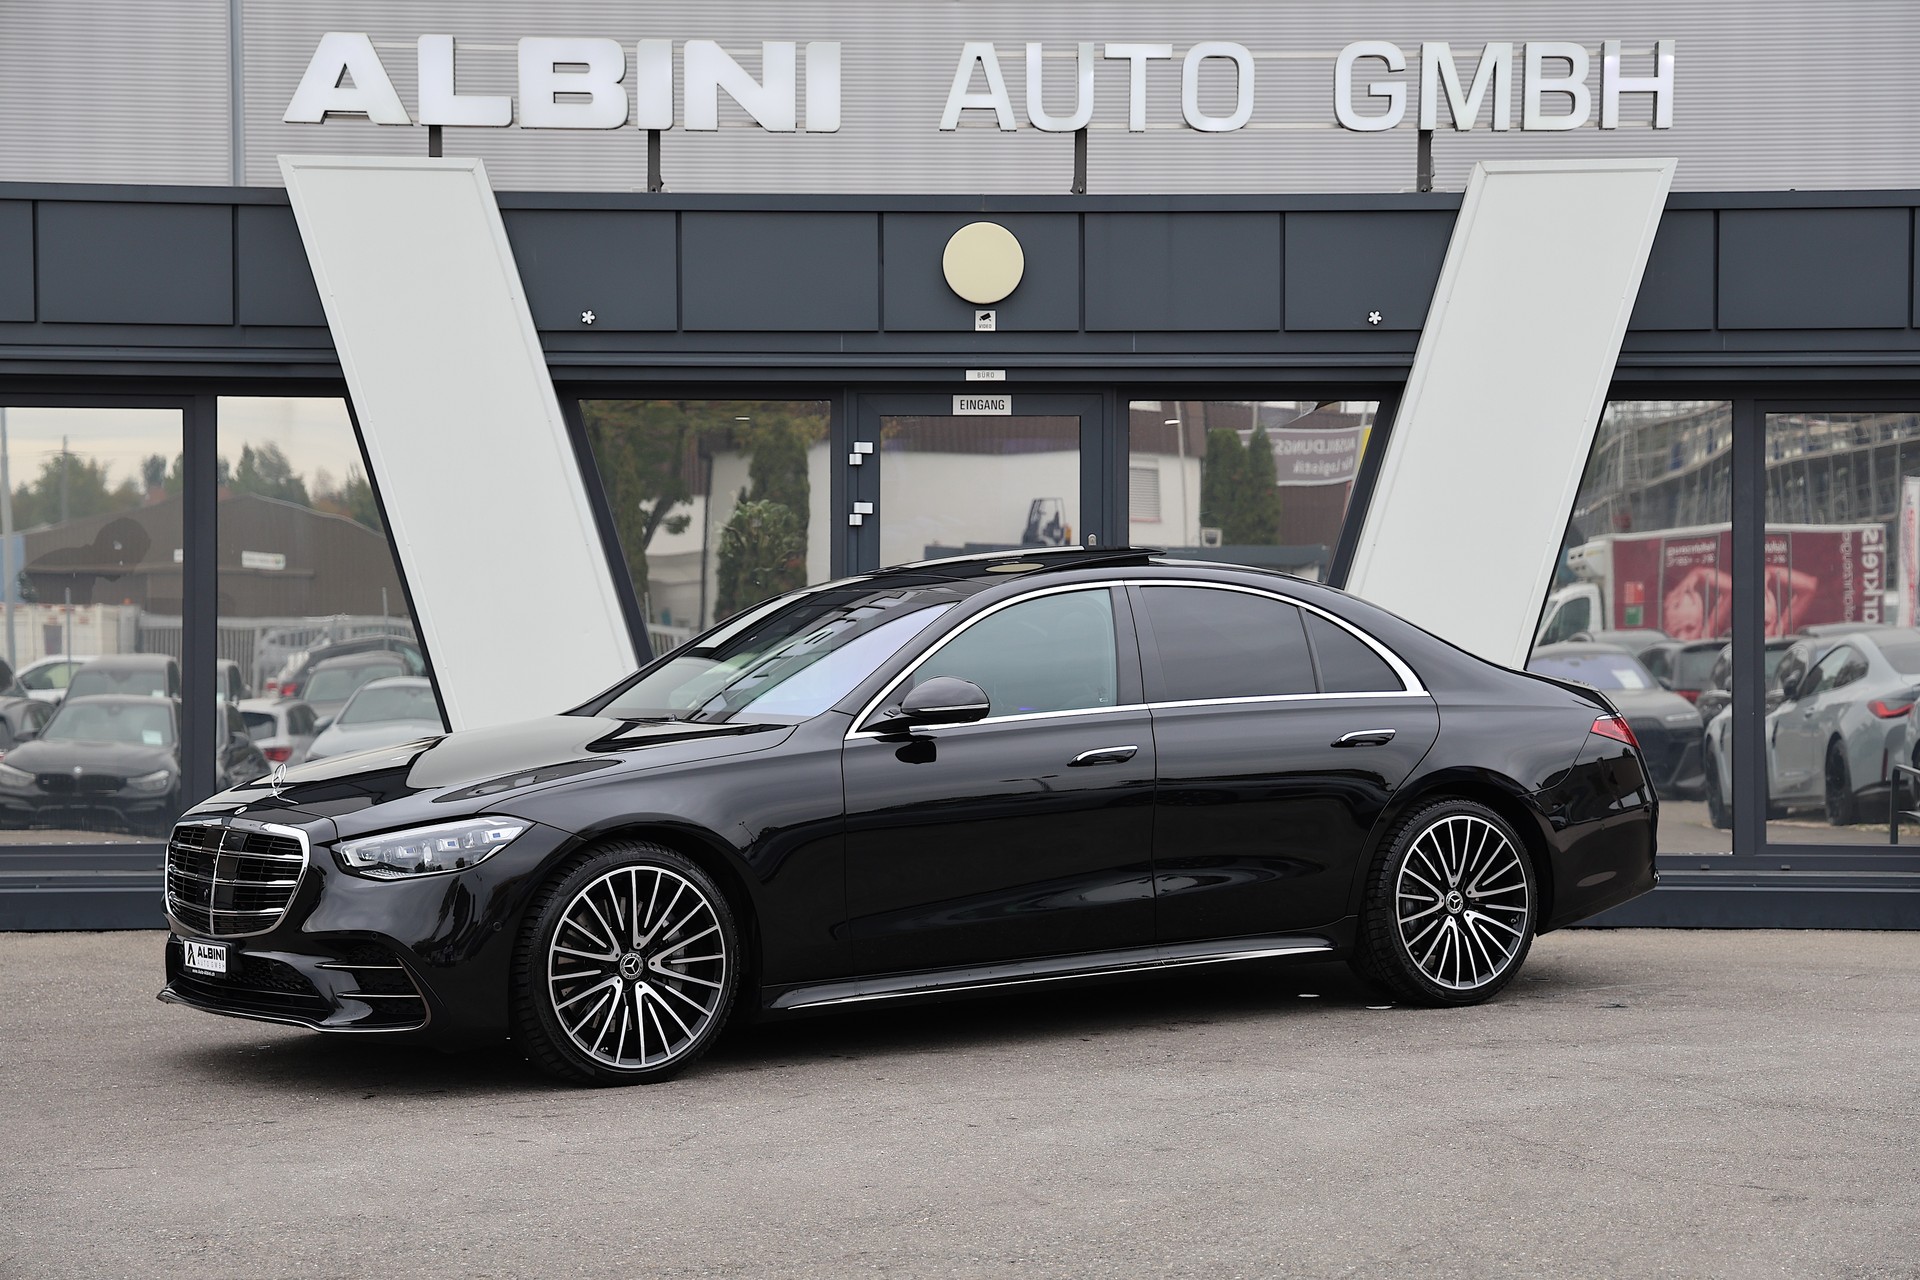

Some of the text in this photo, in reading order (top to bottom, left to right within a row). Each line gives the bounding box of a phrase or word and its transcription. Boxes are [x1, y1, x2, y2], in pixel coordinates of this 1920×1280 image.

[283, 32, 1676, 133] ALBINI AUTO GMBH
[960, 399, 1005, 411] EINGANG
[197, 946, 225, 961] ALBINI
